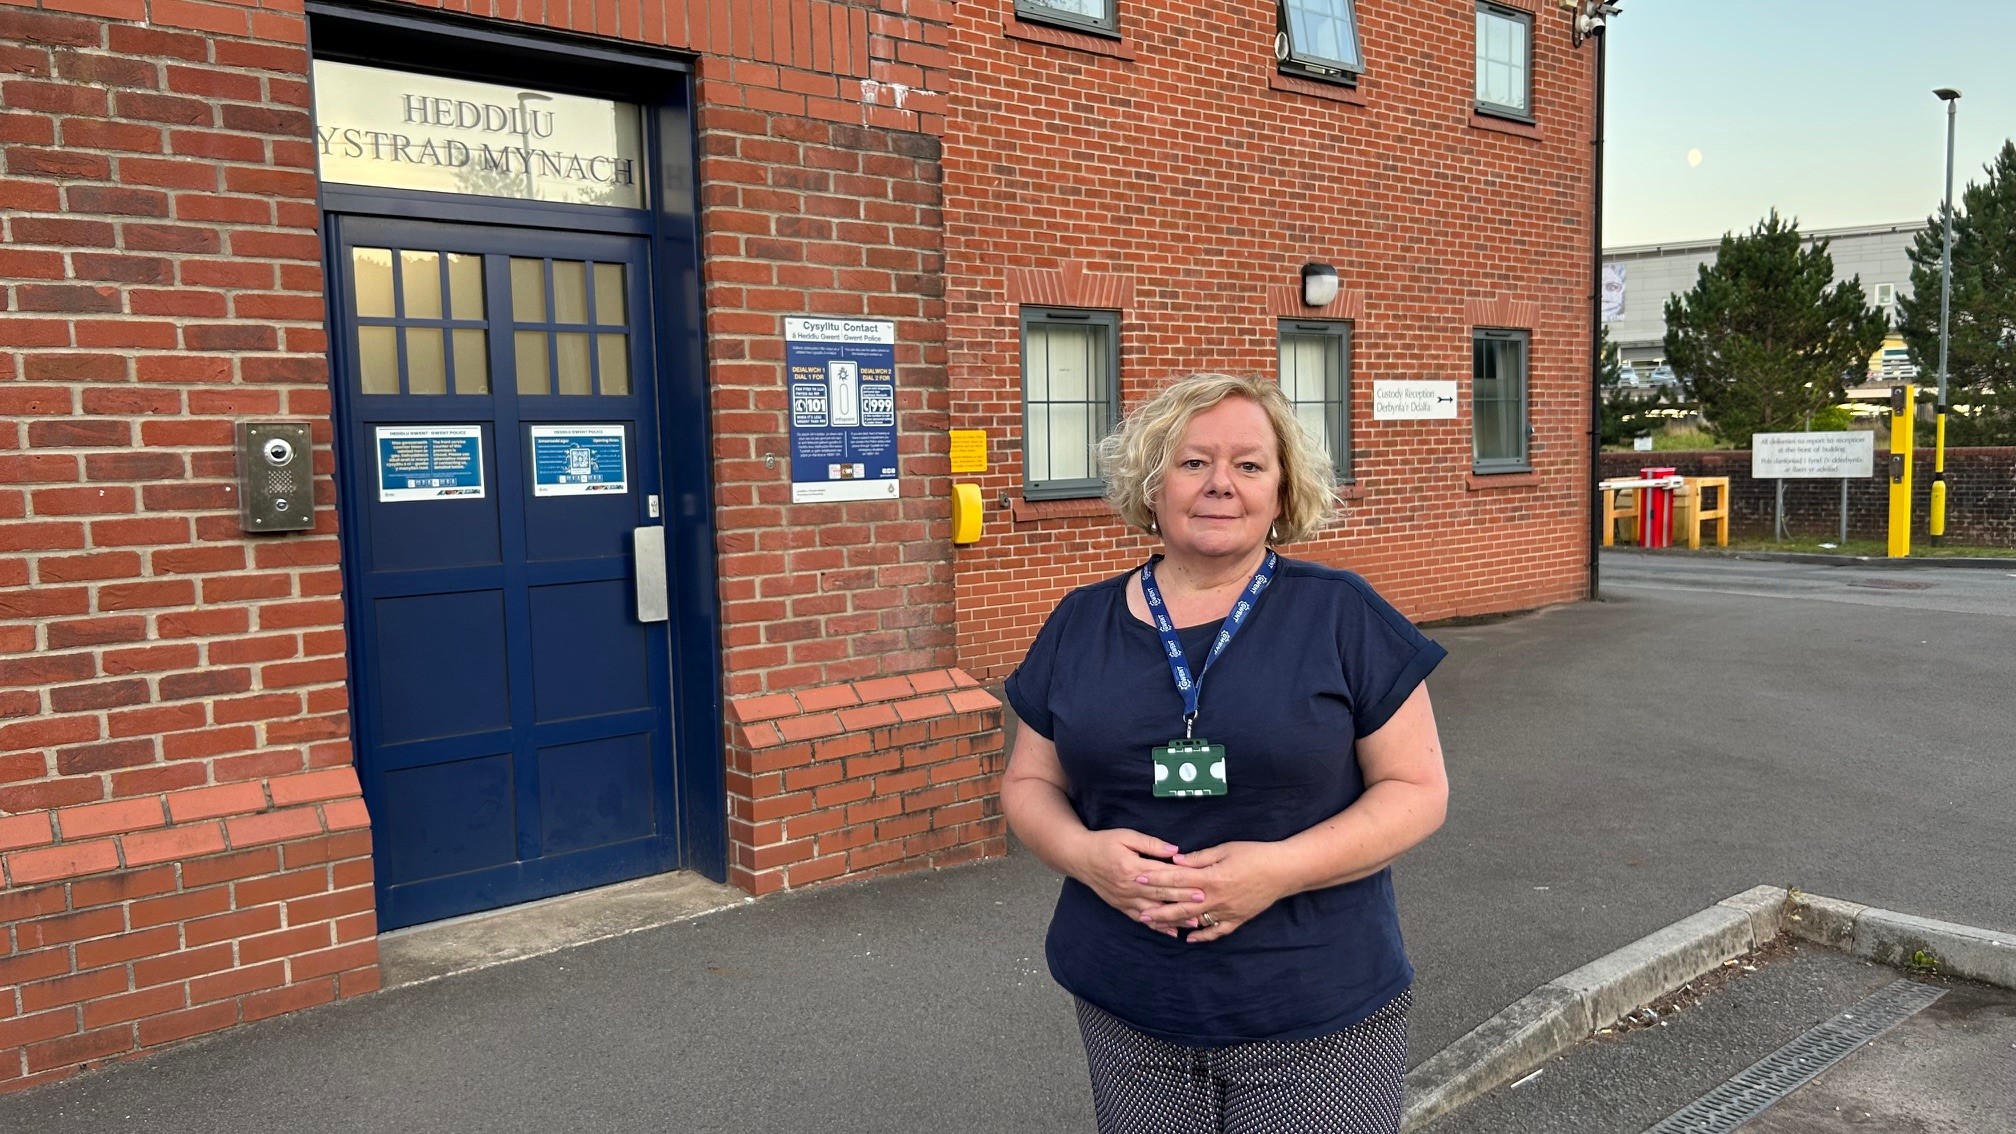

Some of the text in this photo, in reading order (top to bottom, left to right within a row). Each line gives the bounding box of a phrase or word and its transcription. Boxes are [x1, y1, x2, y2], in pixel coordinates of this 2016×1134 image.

[403, 93, 555, 138] HEDDLU
[317, 125, 635, 185] YSTRAD MYNACH
[803, 321, 840, 332] Cysylltu
[843, 322, 879, 333] Contact
[798, 332, 819, 340] Heddlu
[1376, 388, 1434, 401] Custody Reception
[808, 399, 825, 412] 101
[870, 399, 892, 412] 999
[1250, 574, 1267, 594] GWENT
[1232, 600, 1250, 623] GWENT
[1177, 666, 1190, 689] GWENT
